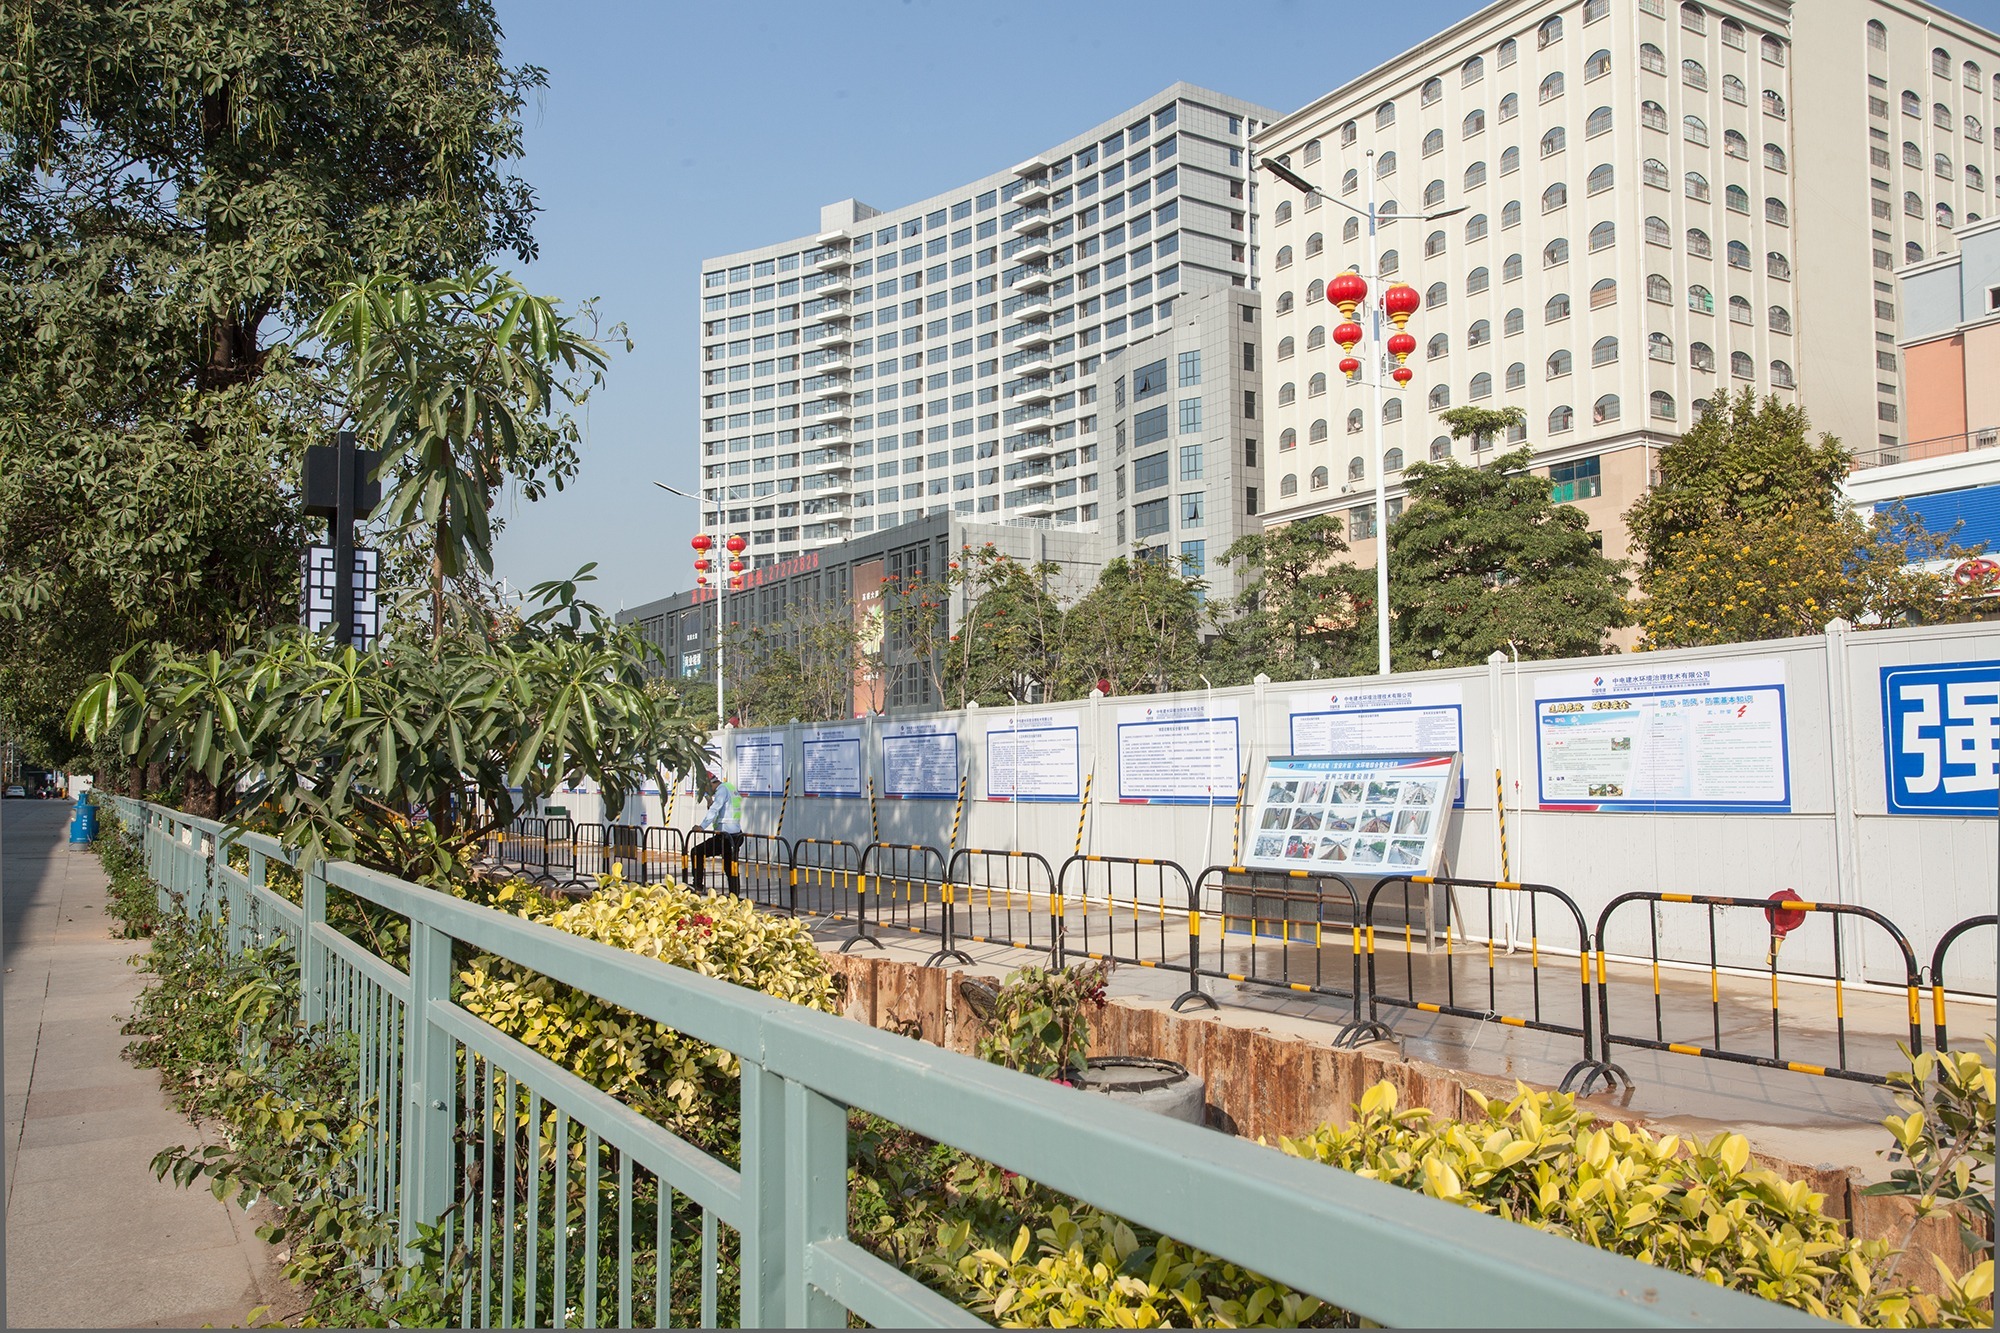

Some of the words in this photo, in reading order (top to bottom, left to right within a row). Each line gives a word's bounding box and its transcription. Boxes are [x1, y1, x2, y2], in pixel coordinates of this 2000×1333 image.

[1612, 670, 1711, 684] 中电建水环境治理技术有限公司
[1899, 681, 1998, 794] 强
